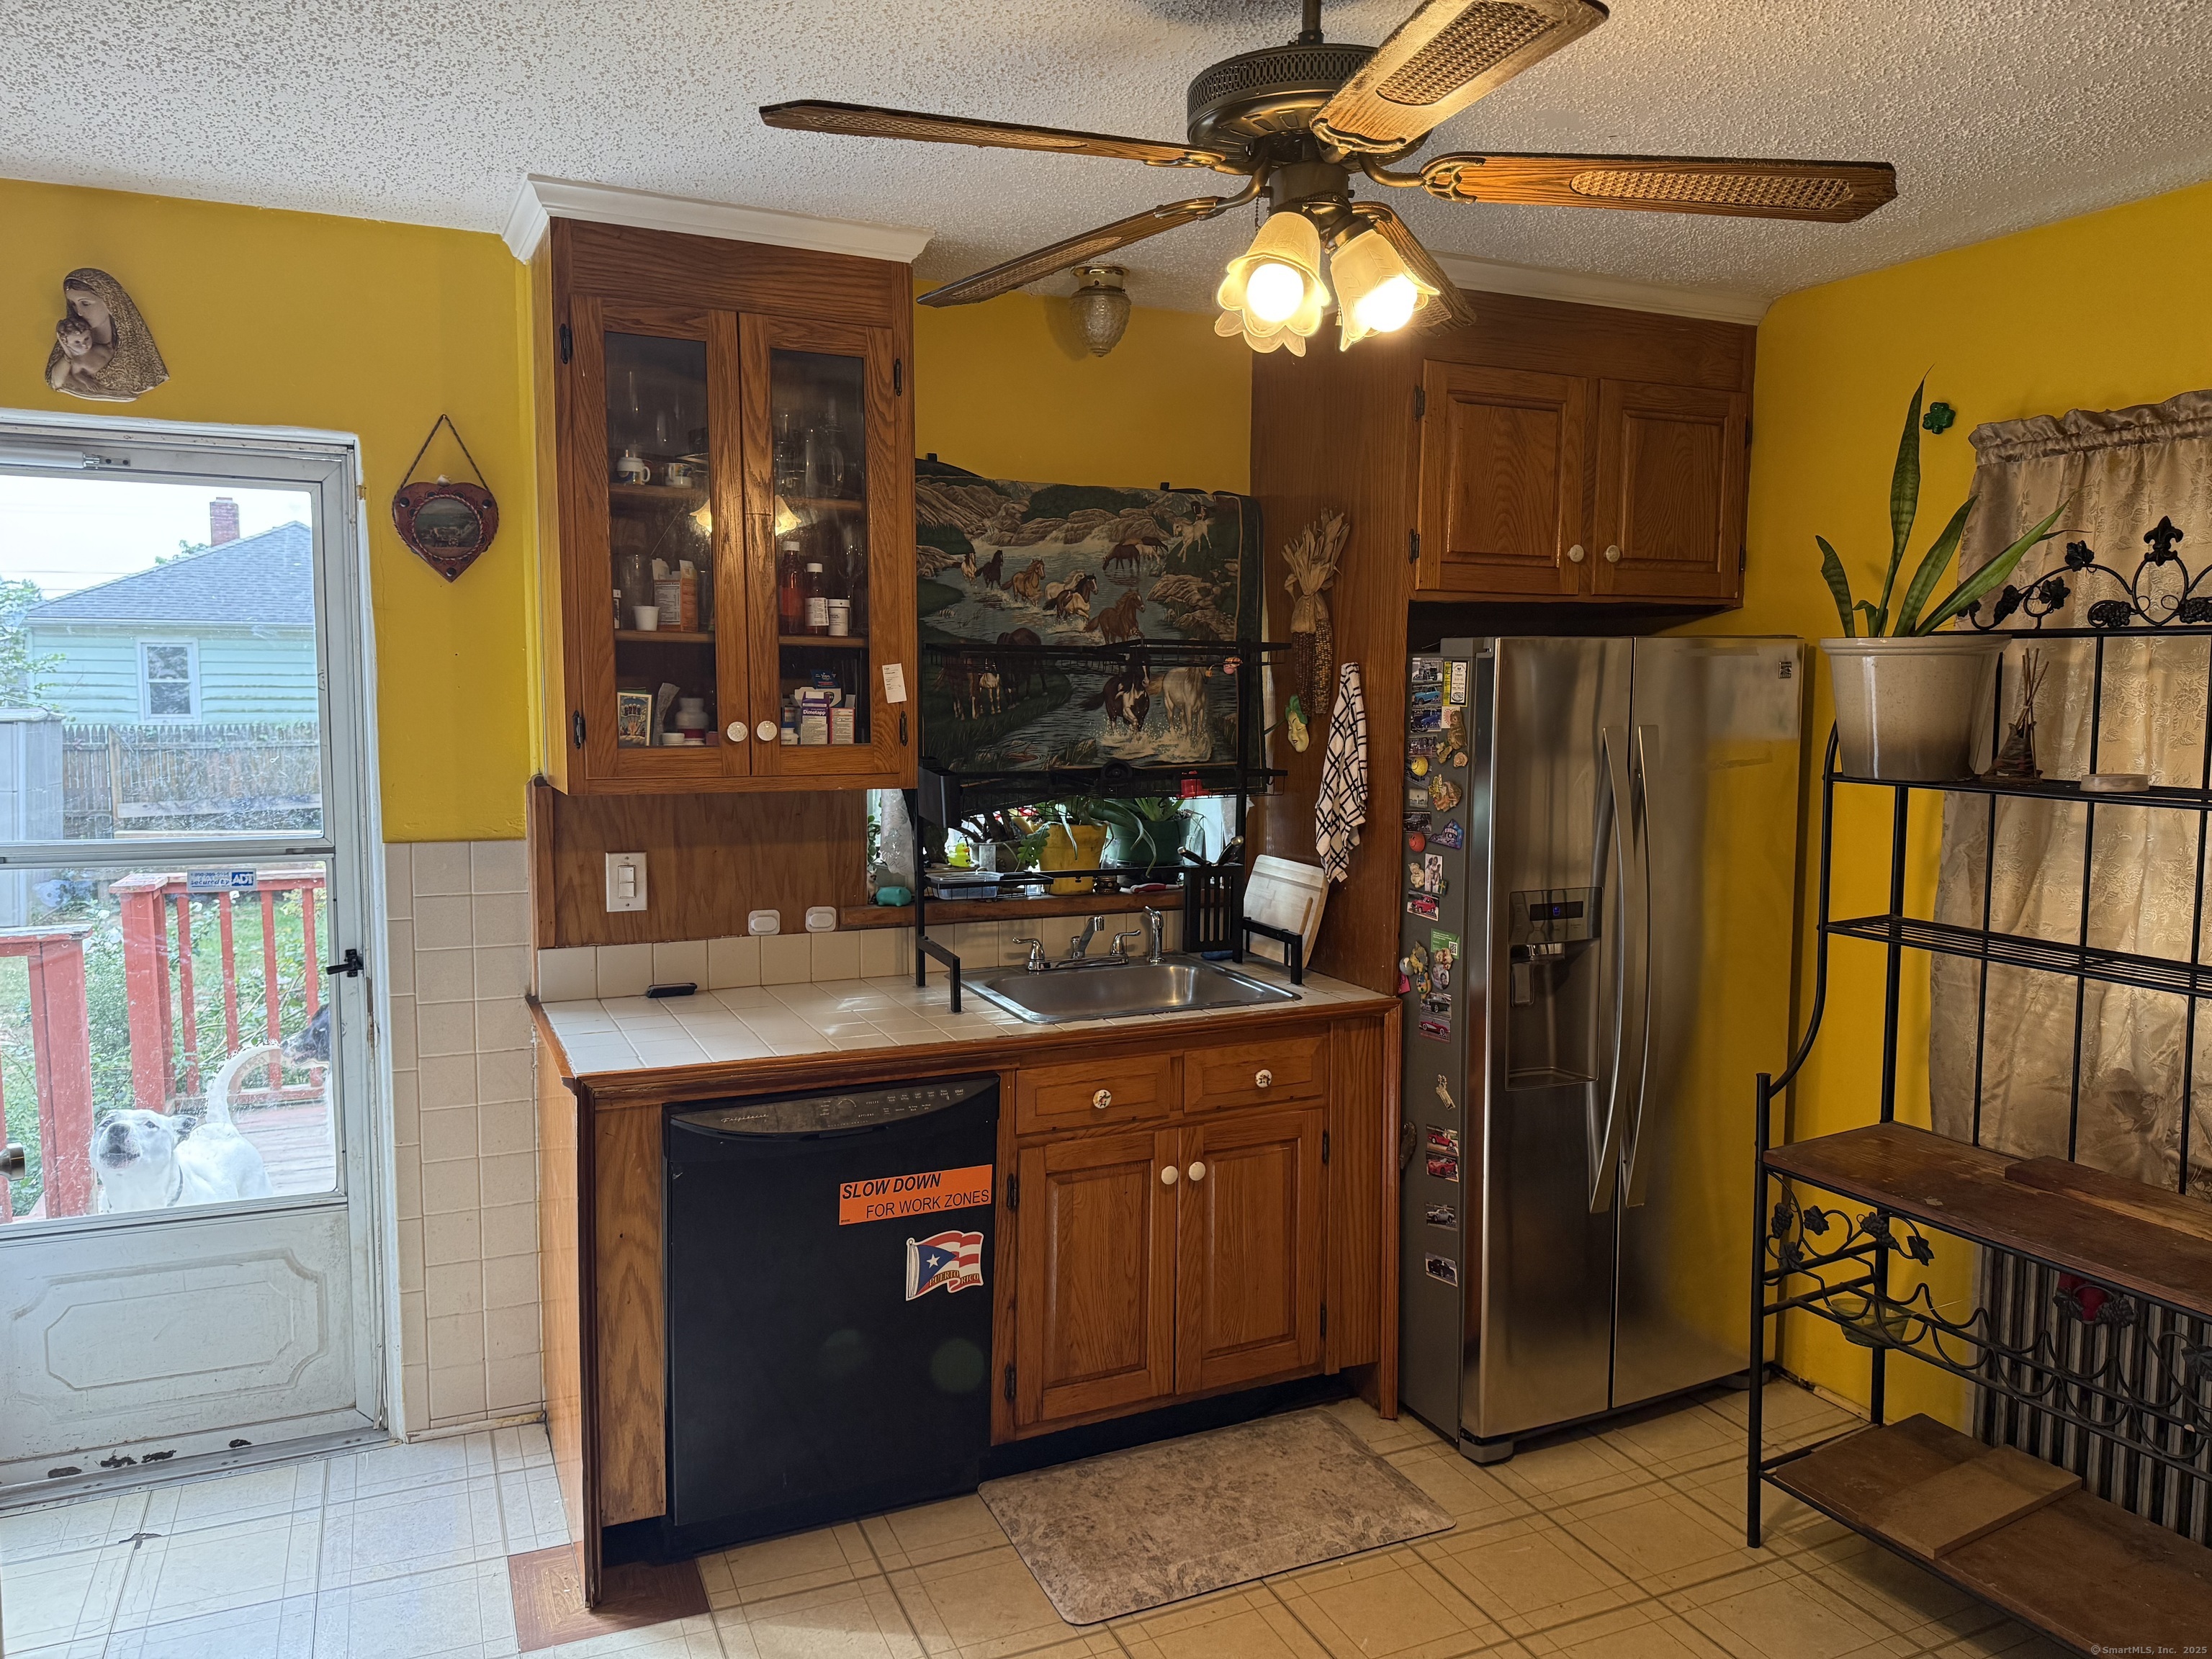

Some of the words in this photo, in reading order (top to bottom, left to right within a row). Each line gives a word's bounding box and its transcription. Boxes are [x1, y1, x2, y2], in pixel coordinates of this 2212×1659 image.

[231, 873, 253, 884] ADT
[842, 1179, 891, 1200] SLOW
[893, 1172, 941, 1193] DOWN
[866, 1202, 896, 1218] FOR
[899, 1196, 941, 1214] WORK
[944, 1190, 989, 1208] ZONES
[929, 1270, 959, 1287] PUERTO
[961, 1274, 979, 1285] RICO
